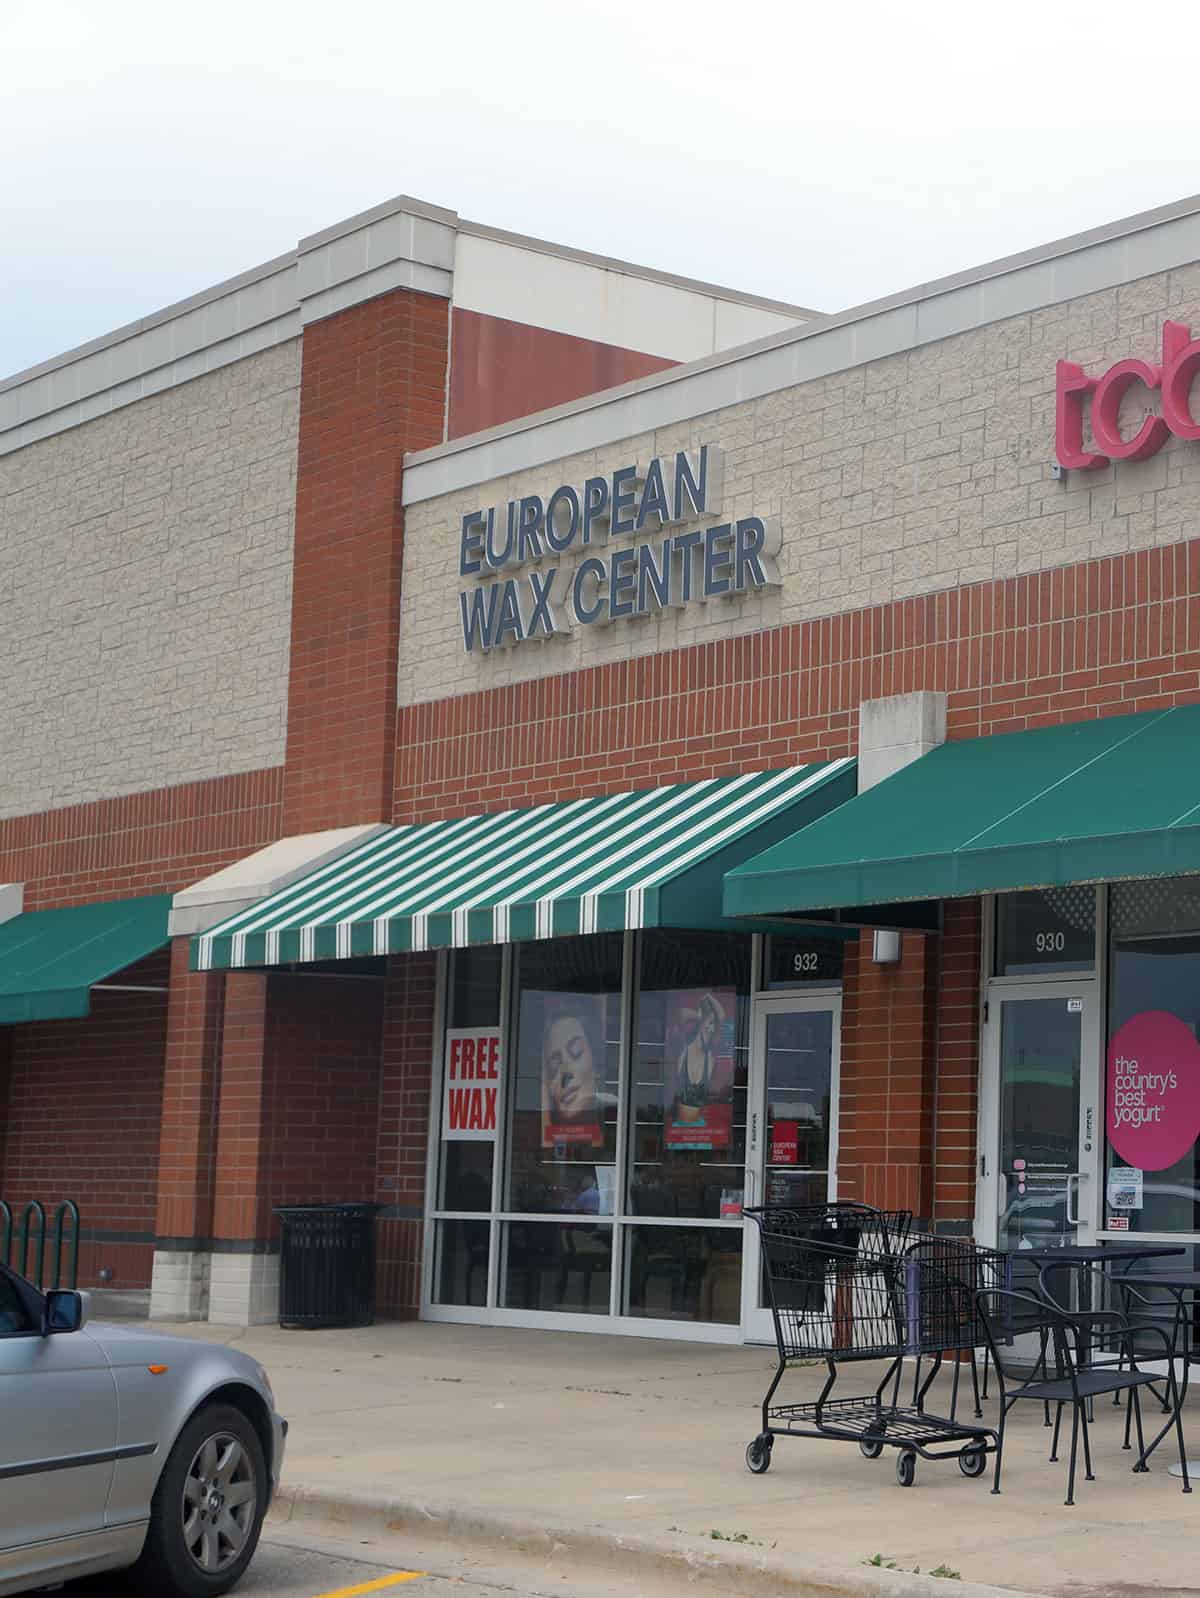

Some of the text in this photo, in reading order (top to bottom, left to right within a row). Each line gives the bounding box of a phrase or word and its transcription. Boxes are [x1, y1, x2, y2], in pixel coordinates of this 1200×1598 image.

[459, 444, 718, 578] EUROPEAN
[460, 516, 778, 654] WAX CENTER
[1036, 932, 1065, 952] 930
[794, 953, 818, 972] 932
[449, 1037, 499, 1080] FREE
[1115, 1056, 1139, 1074] the
[1115, 1069, 1177, 1095] country's
[448, 1087, 497, 1130] WAX
[1114, 1089, 1146, 1106] best
[1114, 1105, 1161, 1129] yogurt
